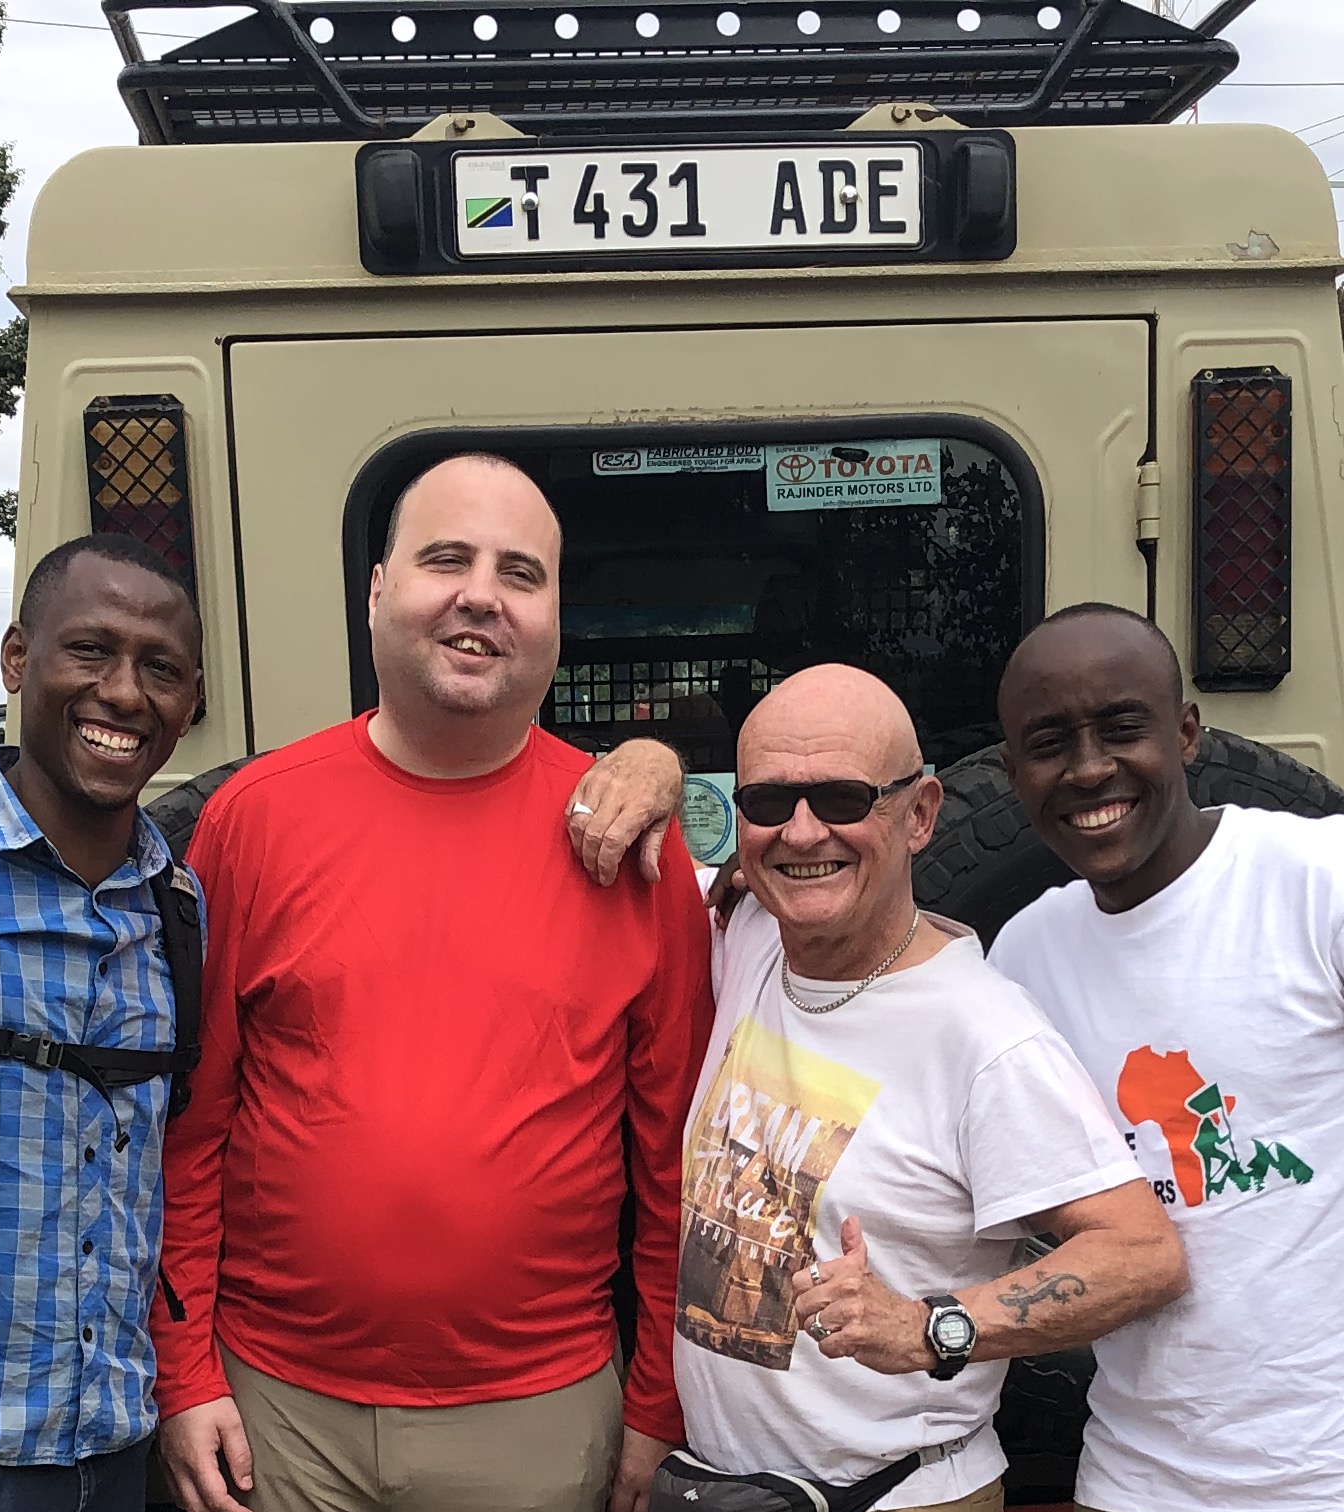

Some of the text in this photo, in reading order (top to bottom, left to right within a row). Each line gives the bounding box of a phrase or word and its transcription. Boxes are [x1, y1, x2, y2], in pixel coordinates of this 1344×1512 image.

[509, 158, 908, 240] T 431 ADE
[601, 454, 635, 468] RSA
[646, 445, 761, 458] FABRICATED BODY
[818, 453, 934, 479] TOYOTA
[777, 481, 936, 500] RAJINDER MOTORS LTD.
